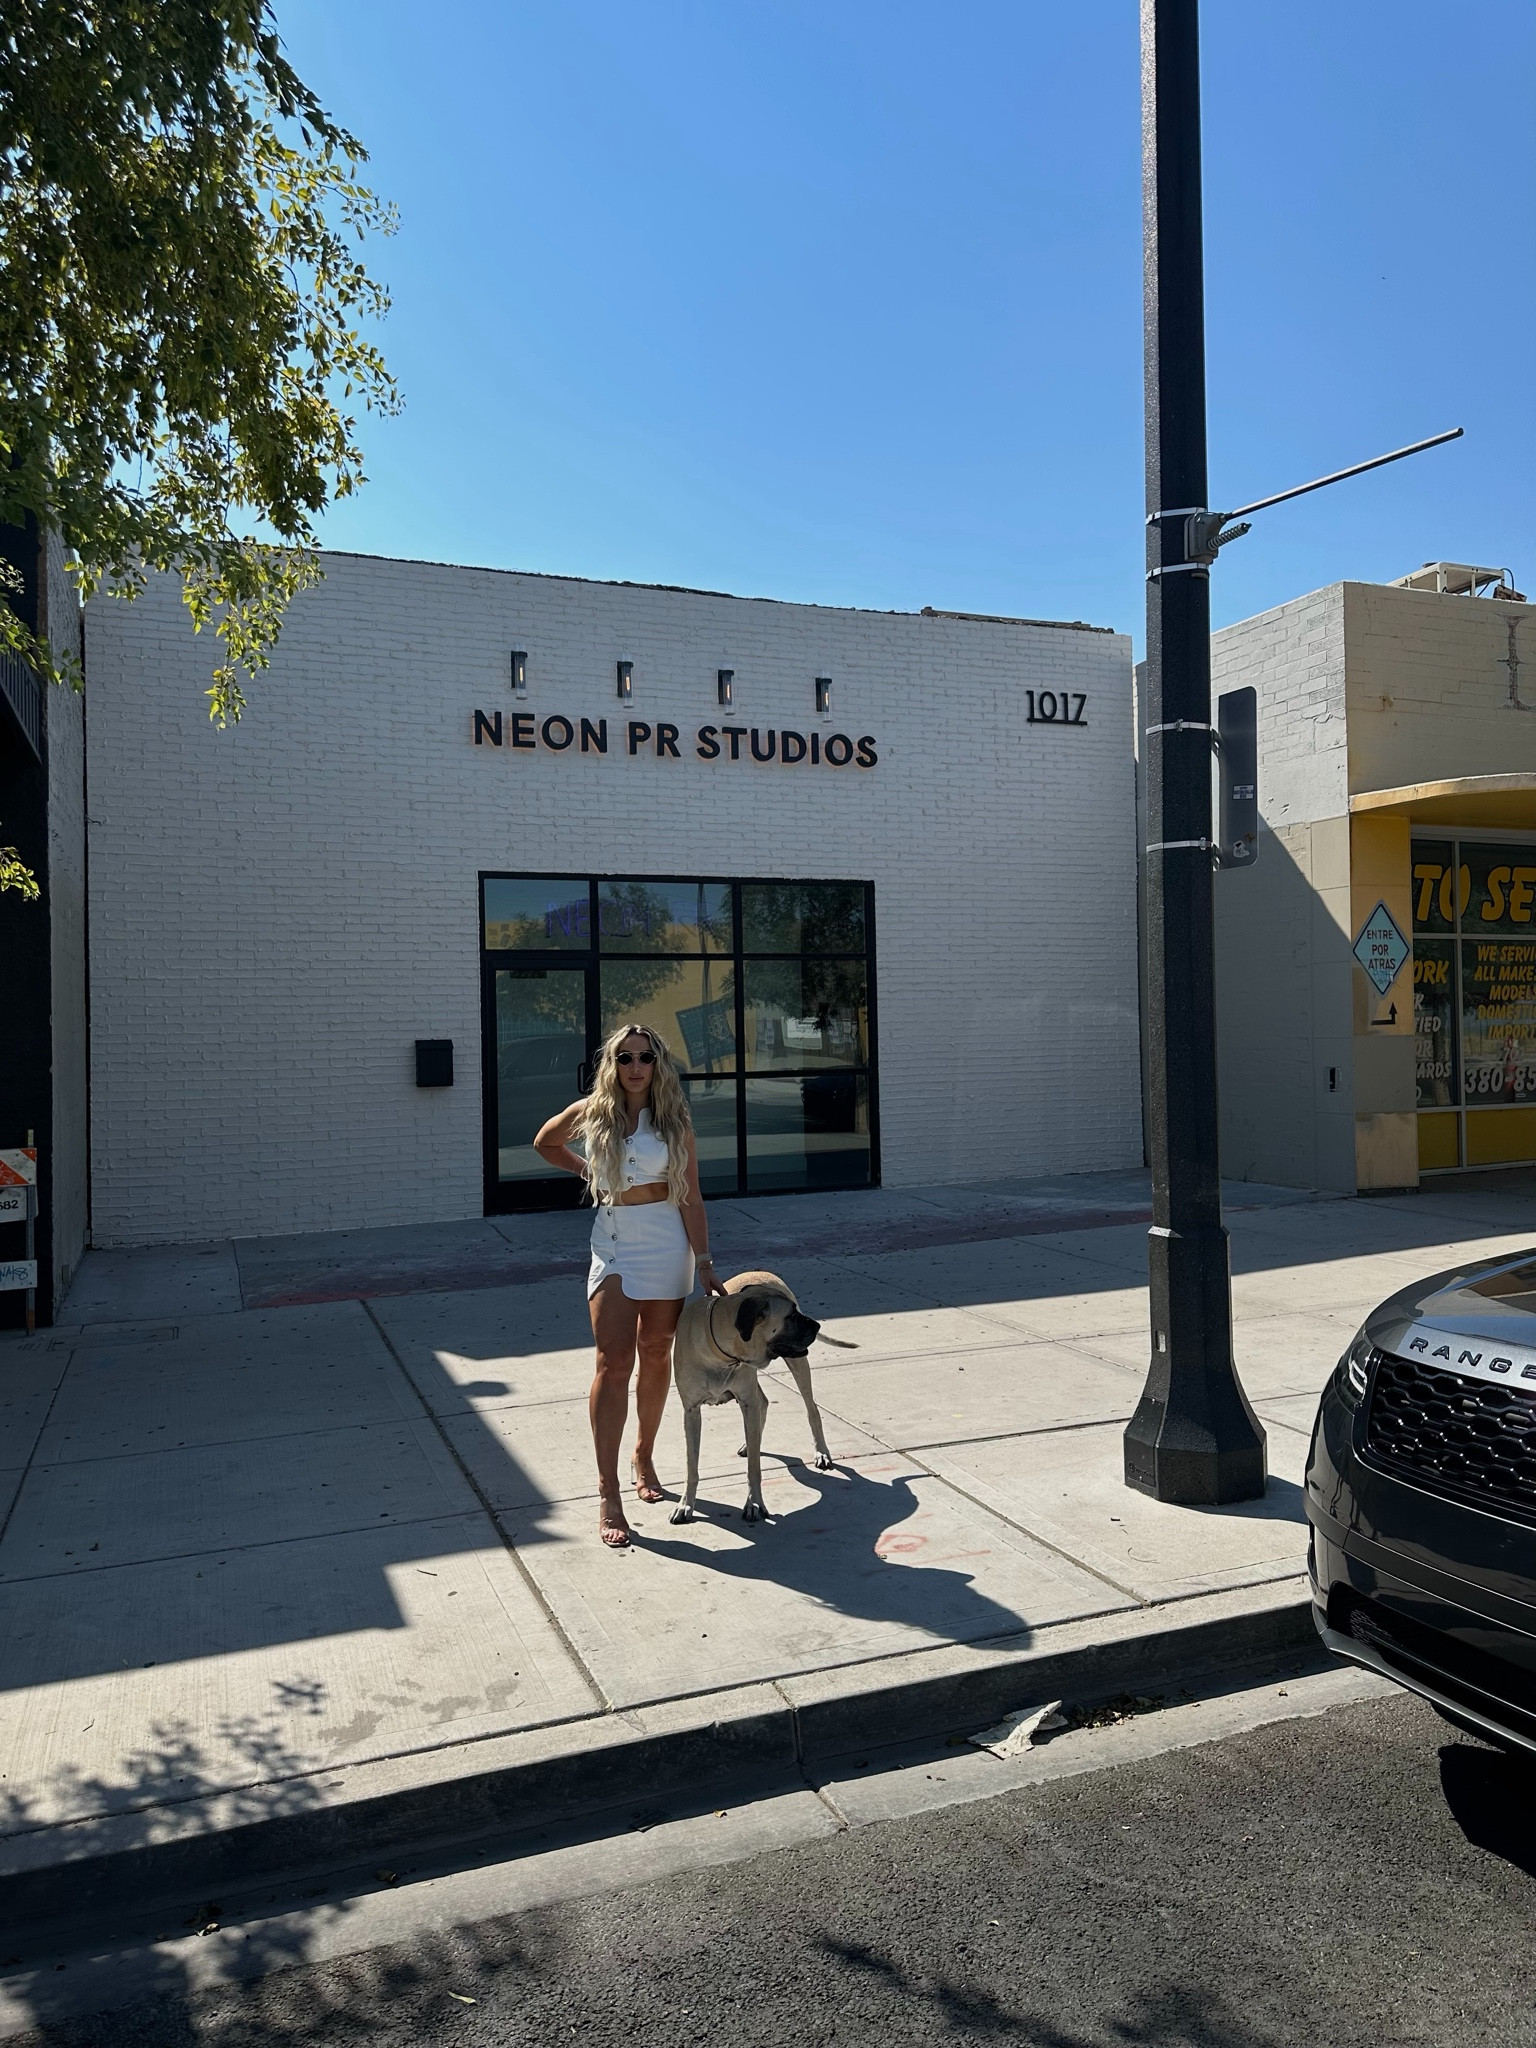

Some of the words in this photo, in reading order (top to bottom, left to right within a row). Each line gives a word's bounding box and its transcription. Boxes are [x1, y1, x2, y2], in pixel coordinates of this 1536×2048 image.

[1026, 690, 1088, 725] 1017
[474, 709, 607, 753] NEON
[628, 721, 681, 757] PR
[697, 725, 878, 768] STUDIOS
[1366, 929, 1394, 940] ENTRE
[1371, 944, 1389, 956] POR
[1477, 944, 1497, 961] WE
[1499, 944, 1536, 962] SERVI
[1368, 958, 1396, 970] ATRAS
[1474, 965, 1496, 982] ALL
[1416, 1061, 1452, 1080] ARDS
[1409, 1336, 1536, 1380] RANGE
